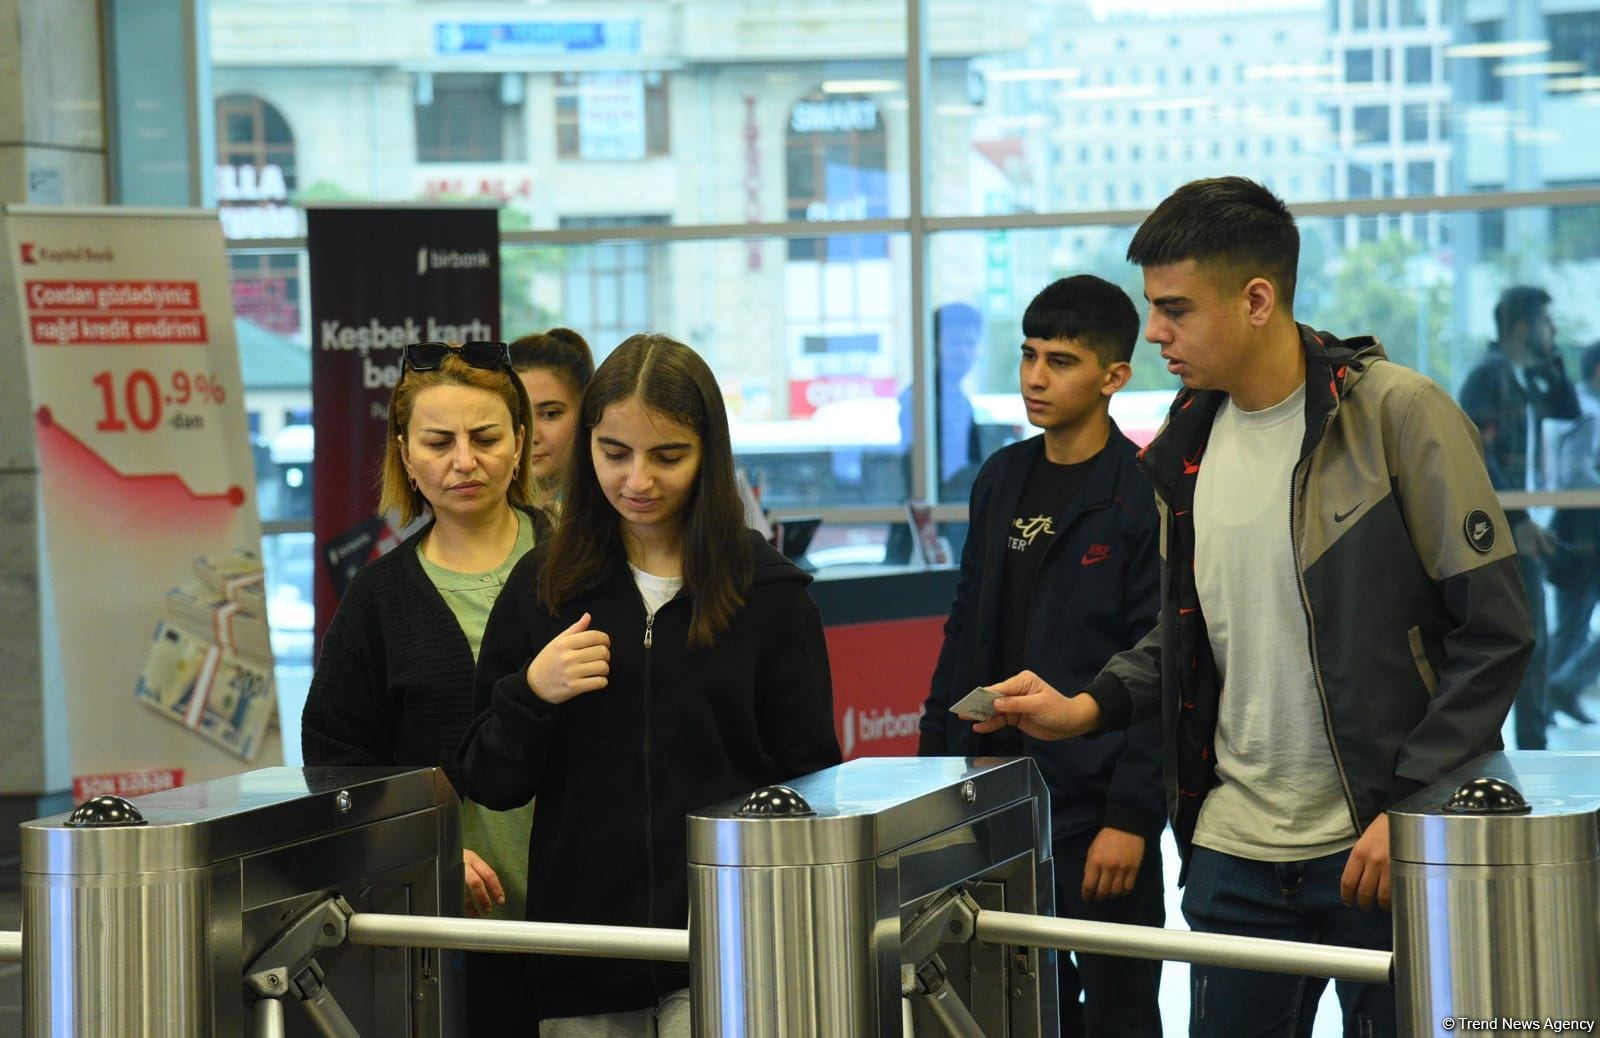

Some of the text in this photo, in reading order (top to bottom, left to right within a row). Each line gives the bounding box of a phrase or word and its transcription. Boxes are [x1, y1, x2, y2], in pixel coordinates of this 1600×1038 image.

[791, 101, 876, 132] SMART
[430, 250, 490, 269] birbank
[35, 318, 199, 344] nağd kredit endirimi
[321, 318, 421, 356] Keşbek
